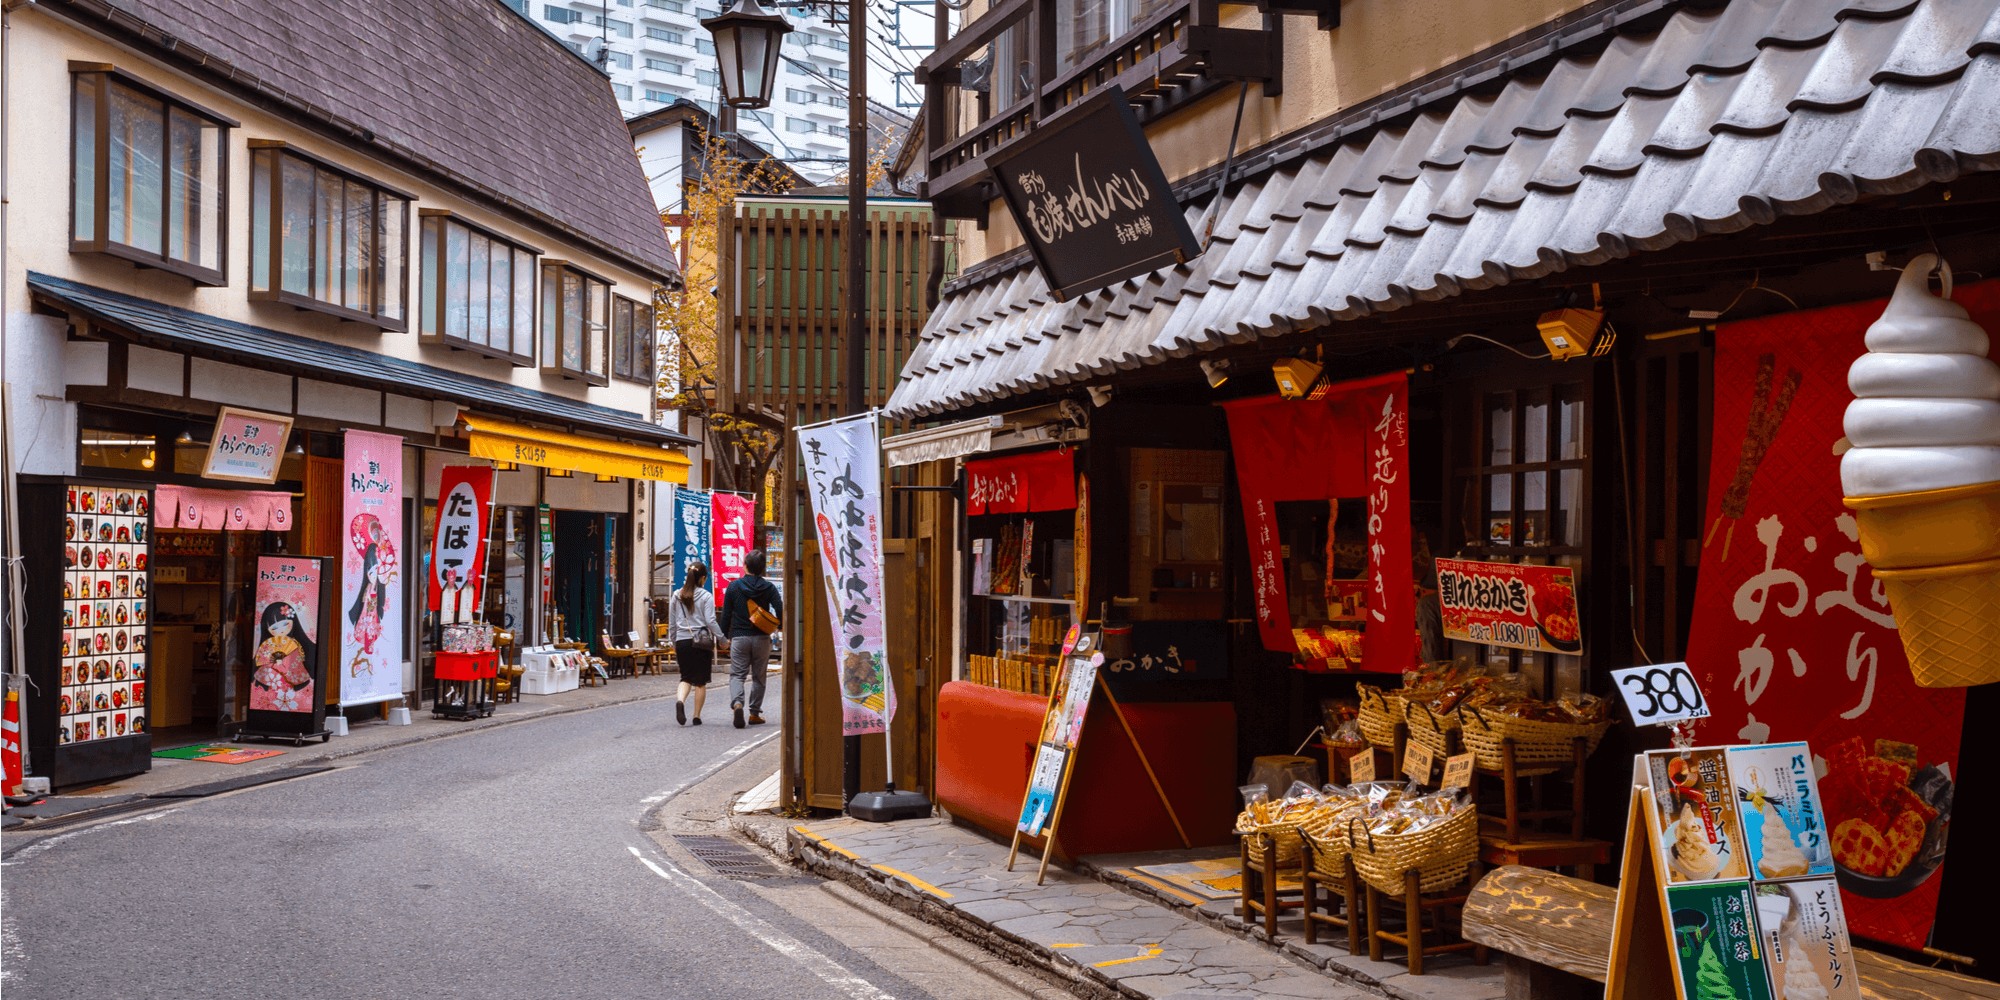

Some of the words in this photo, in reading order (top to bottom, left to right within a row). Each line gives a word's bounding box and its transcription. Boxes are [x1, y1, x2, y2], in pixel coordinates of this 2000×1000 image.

[441, 492, 472, 582] たばこ
[1440, 570, 1527, 613] 割れおかき
[1110, 645, 1182, 674] おかき
[1623, 668, 1703, 717] 380
[1699, 758, 1730, 855] 醤油アイス
[1791, 754, 1820, 848] バニラミルク
[1726, 895, 1751, 962] お抹茶
[1815, 890, 1843, 989] とうふミルク
